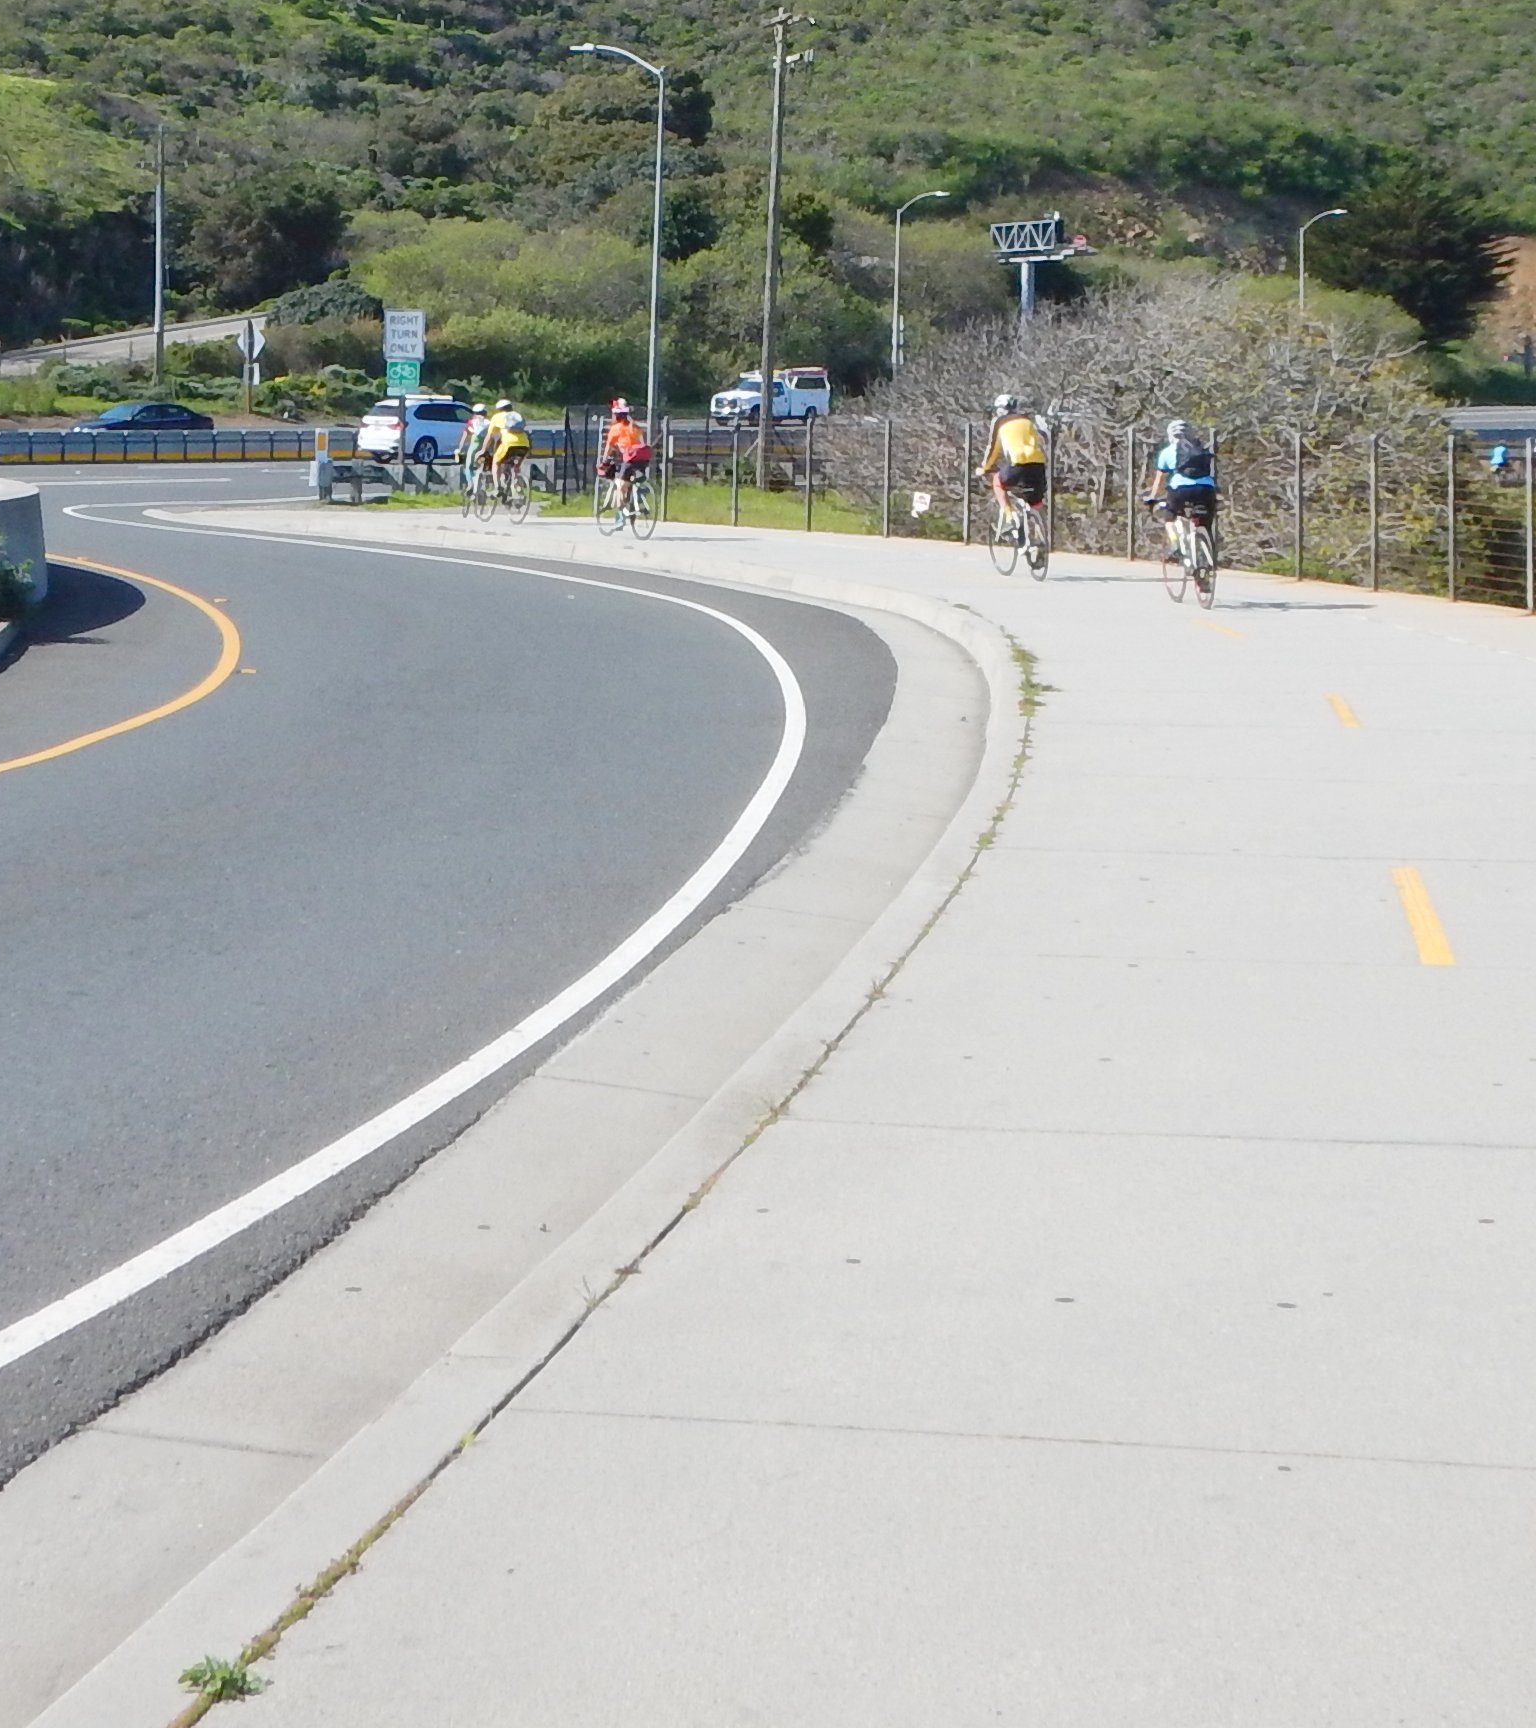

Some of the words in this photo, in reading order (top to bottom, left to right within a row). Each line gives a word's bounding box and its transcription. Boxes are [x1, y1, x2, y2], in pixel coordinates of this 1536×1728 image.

[389, 315, 419, 325] RIGHT
[391, 329, 418, 339] TURN
[389, 343, 417, 353] ONLY
